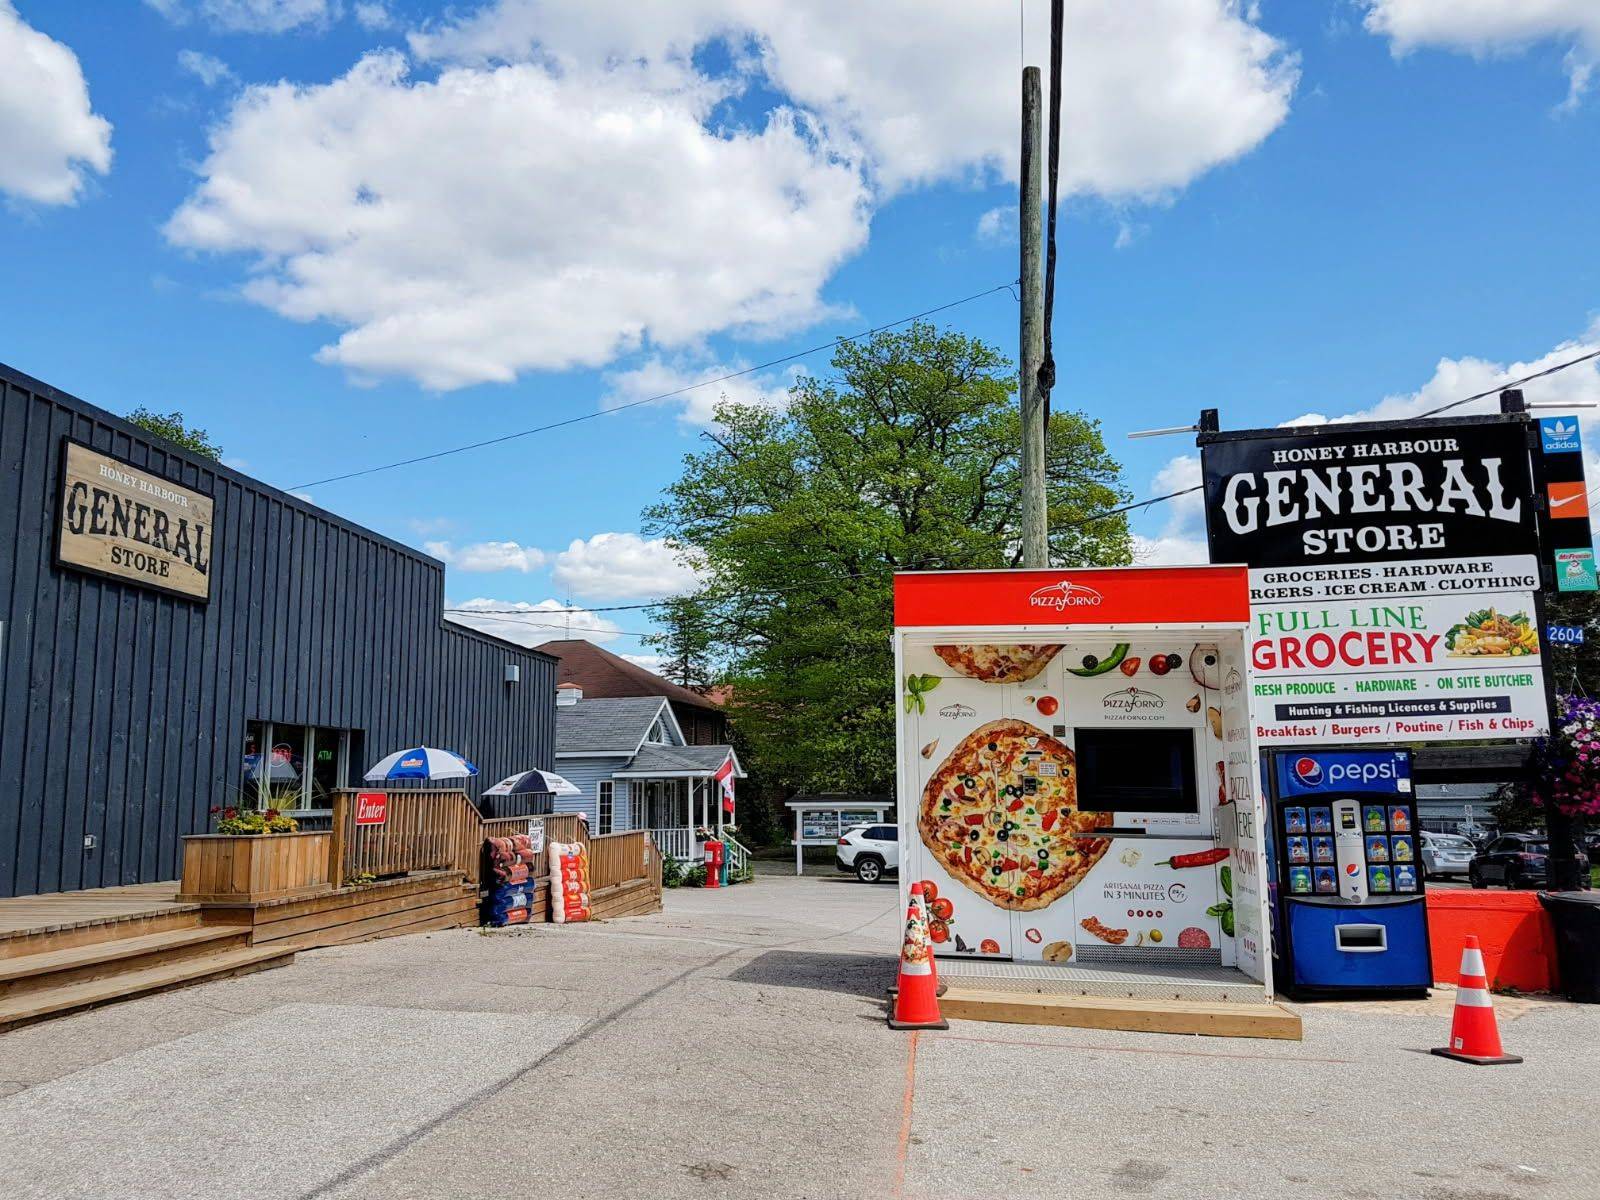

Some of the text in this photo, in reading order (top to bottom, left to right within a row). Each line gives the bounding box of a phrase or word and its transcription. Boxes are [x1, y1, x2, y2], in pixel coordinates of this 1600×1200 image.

[1272, 438, 1459, 464] HONEY HARBOUR
[1545, 441, 1579, 449] adidas
[100, 464, 188, 507] HONEY HARBOUR
[1222, 458, 1521, 535] GENERAL
[67, 481, 208, 575] GENERAL
[1302, 523, 1446, 555] STORE
[111, 546, 170, 577] STORE
[1263, 562, 1493, 583] GROCERIES HARDWARE
[1250, 576, 1536, 599] RGERS ICE CREAM CLOTHING
[1258, 606, 1427, 636] FULL LINE
[1550, 627, 1584, 642] 2604
[1252, 631, 1441, 671] GROCERY
[1254, 684, 1282, 696] RESH
[1286, 682, 1336, 695] PRODUCE
[1355, 679, 1417, 692] HARDWARE
[1437, 677, 1453, 689] ON
[1457, 676, 1481, 689] SITE
[1485, 674, 1534, 687] BUTCHER
[1288, 699, 1498, 717] Hunting & Fishing Licences & Supplies
[1256, 725, 1317, 737] Breakfast
[1331, 723, 1381, 738] Burgers
[1395, 721, 1443, 733] Poutine
[1458, 719, 1484, 731] Fish
[1489, 718, 1498, 730] &
[1501, 717, 1535, 731] Chips
[317, 750, 333, 760] ATM
[1329, 759, 1396, 784] pepsi
[1230, 776, 1251, 800] PIZZA
[357, 798, 385, 819] Enter
[1238, 812, 1253, 838] ERE
[1103, 890, 1166, 901] IN 3 MINUTES
[1143, 883, 1165, 891] PIZZA
